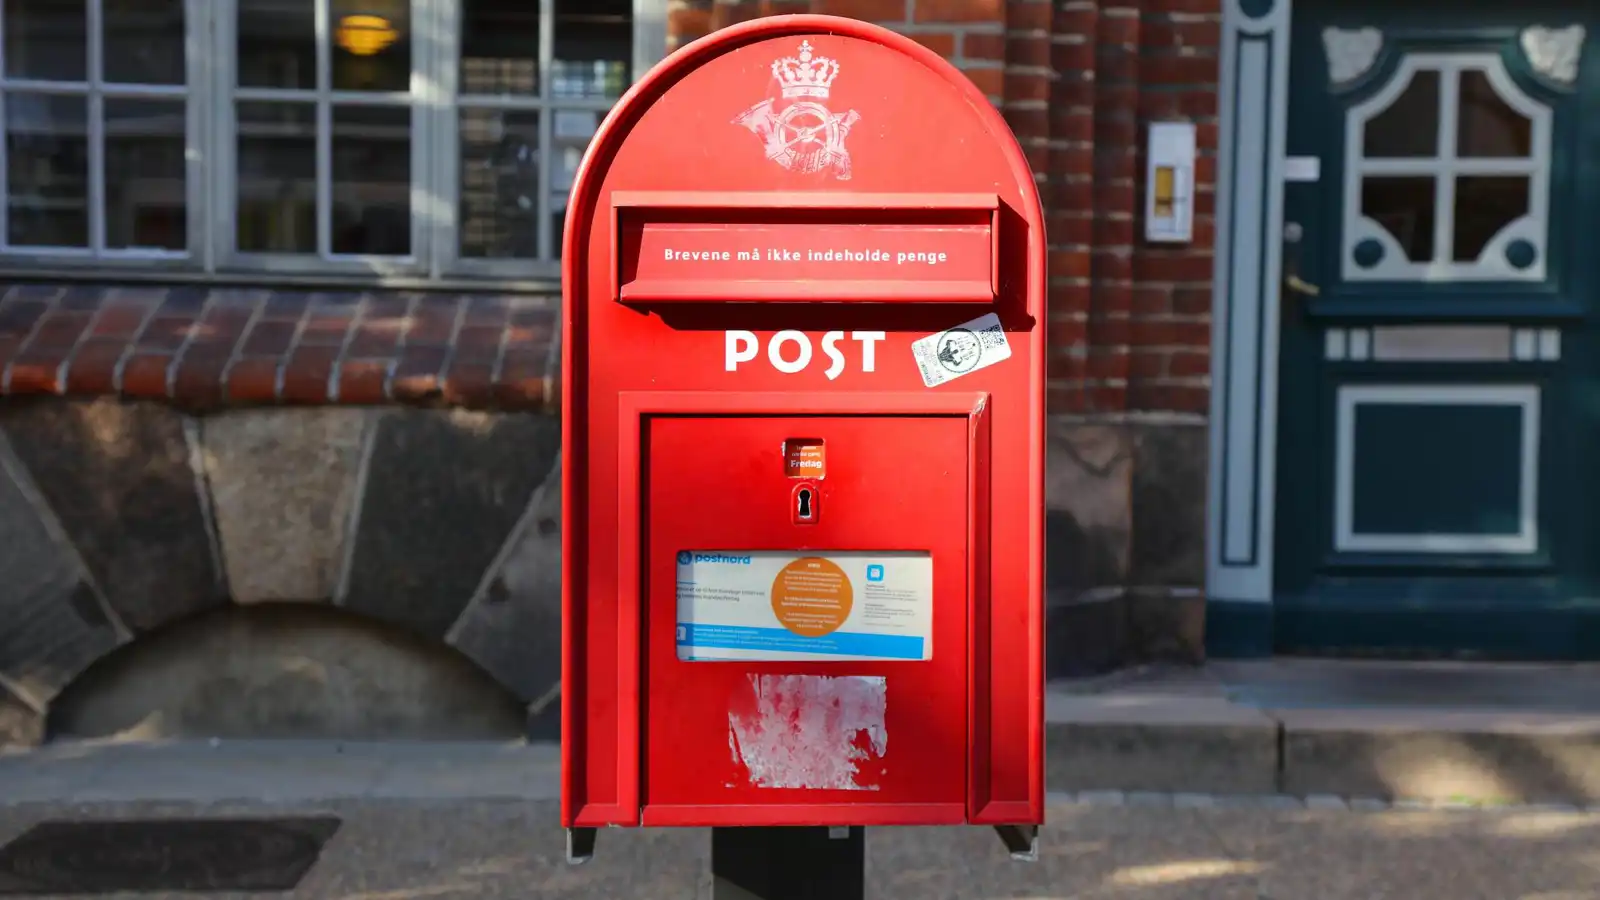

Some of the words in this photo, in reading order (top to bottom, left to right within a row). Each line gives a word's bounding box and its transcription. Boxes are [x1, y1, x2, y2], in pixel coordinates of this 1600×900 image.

[664, 248, 731, 261] Brevene
[737, 248, 760, 261] må
[767, 248, 801, 261] ikke
[808, 248, 891, 262] indeholde
[897, 251, 947, 265] penge
[725, 329, 886, 381] POST
[790, 460, 822, 469] Fredag
[694, 552, 751, 565] postnord
